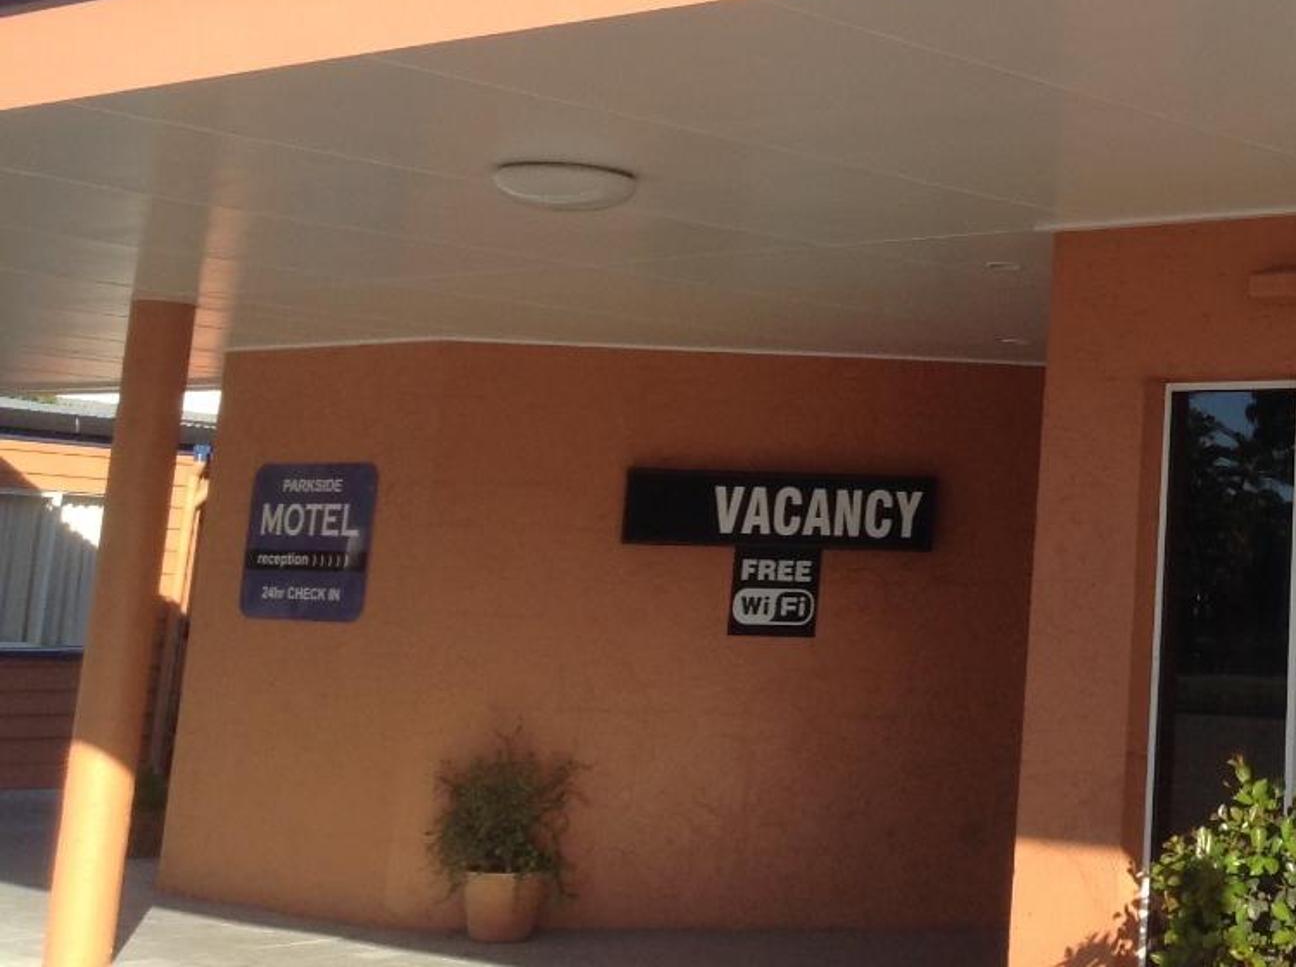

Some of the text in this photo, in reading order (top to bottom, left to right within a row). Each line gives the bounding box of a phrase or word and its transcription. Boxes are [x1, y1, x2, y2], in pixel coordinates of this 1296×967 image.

[283, 479, 343, 493] PARKSIDE
[260, 503, 360, 537] MOTEL
[715, 486, 923, 539] VACANCY
[257, 554, 309, 567] reception
[740, 558, 812, 583] FREE
[261, 586, 341, 601] 24hr CHECK IN
